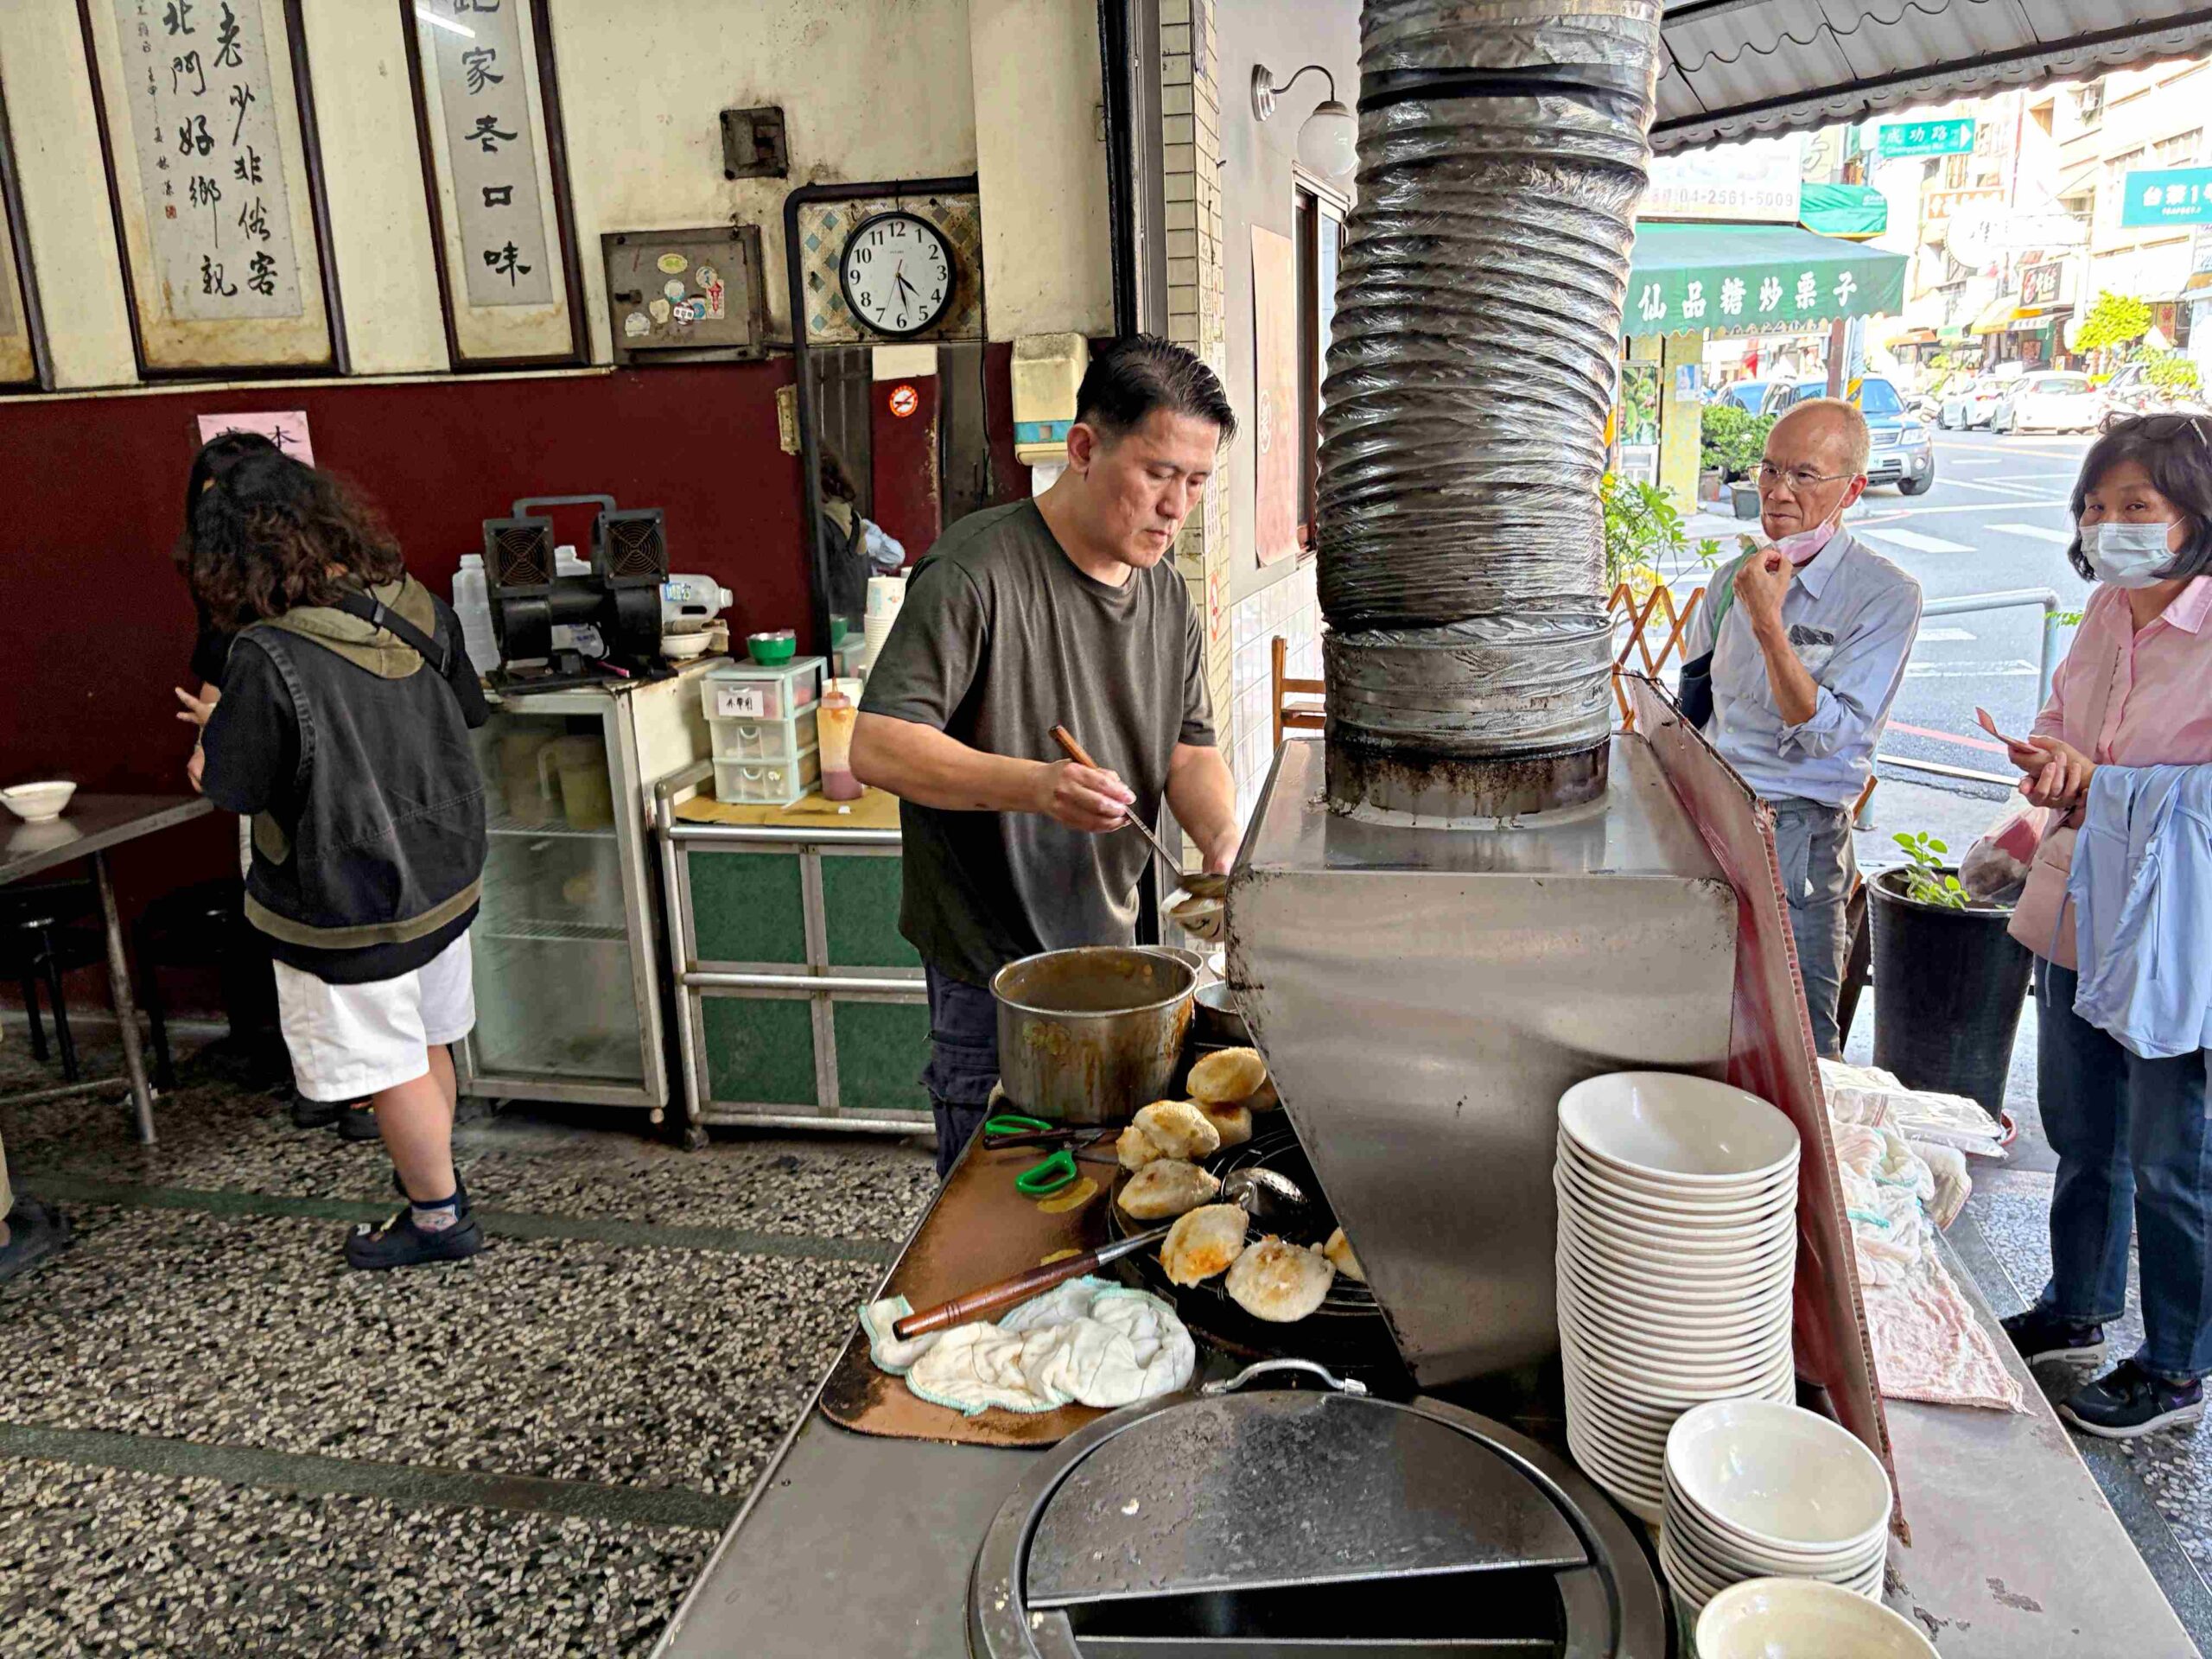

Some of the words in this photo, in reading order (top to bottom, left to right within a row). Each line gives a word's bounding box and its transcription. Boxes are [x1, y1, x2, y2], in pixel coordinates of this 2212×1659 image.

[887, 221, 906, 238] 12
[915, 228, 923, 243] 1
[869, 230, 884, 245] 11
[854, 248, 872, 264] 10
[928, 244, 939, 260] 2
[849, 270, 861, 285] 9
[937, 265, 947, 281] 3
[861, 292, 872, 307] 8
[931, 289, 942, 303] 4
[1637, 270, 1858, 322] 仙品糖炒栗子
[875, 308, 886, 323] 7
[896, 313, 907, 328] 6
[918, 305, 929, 321] 5
